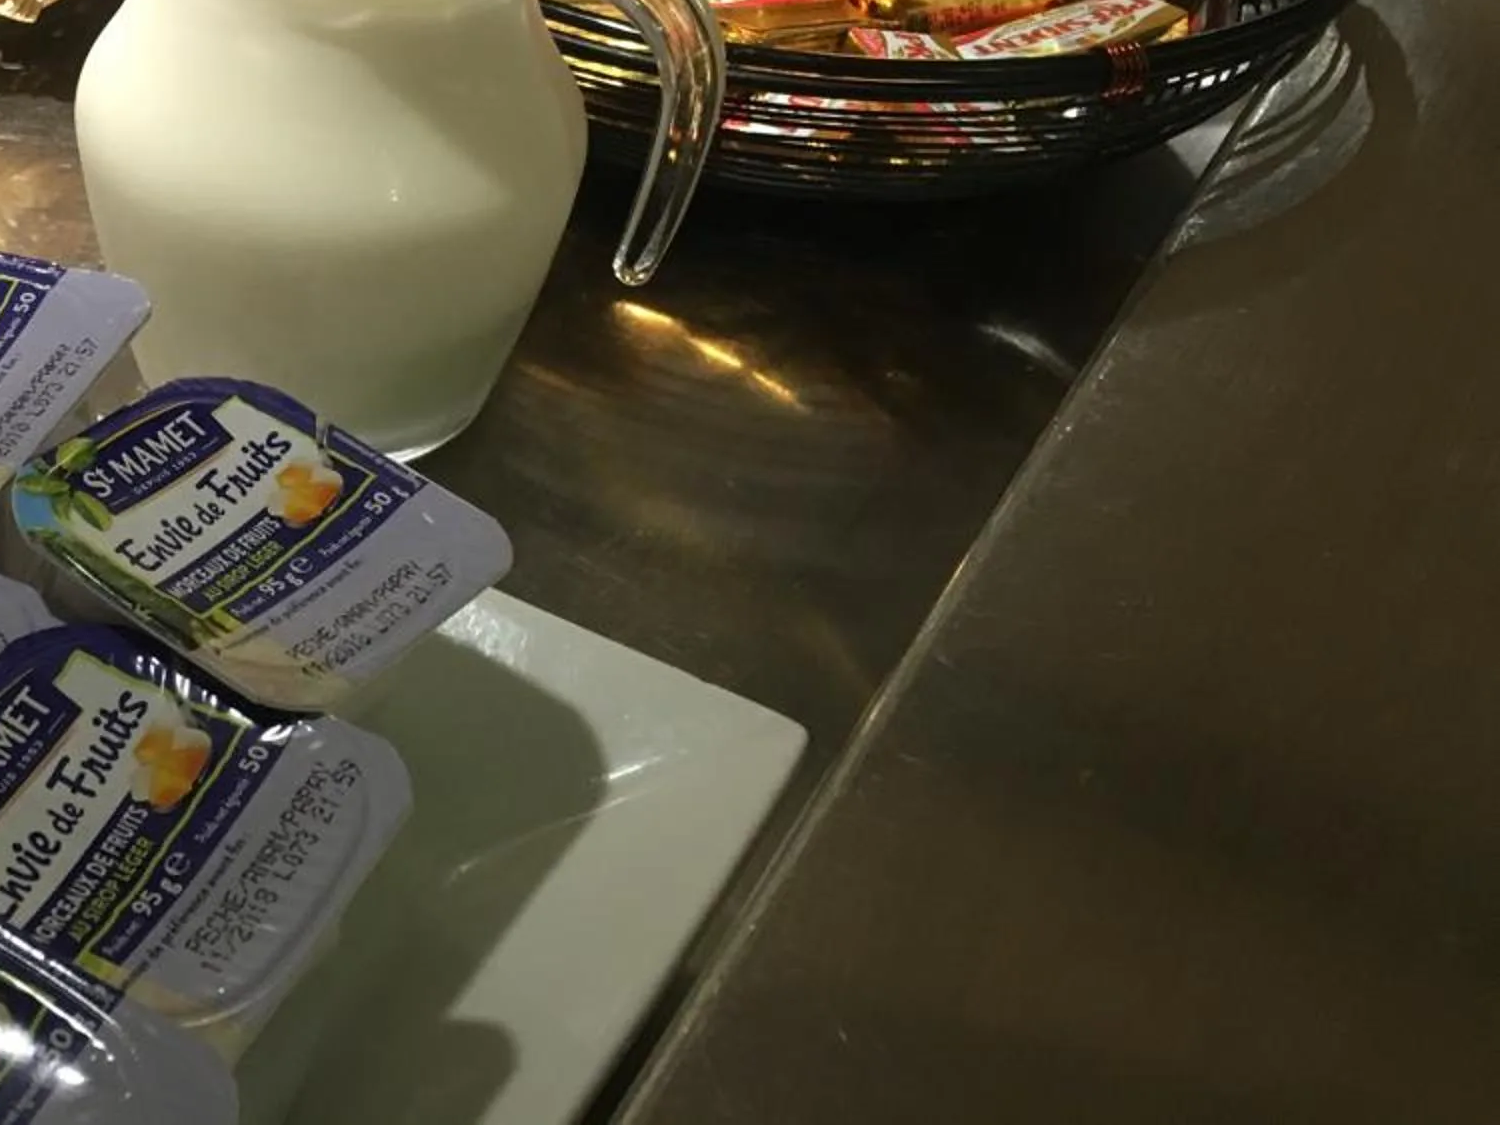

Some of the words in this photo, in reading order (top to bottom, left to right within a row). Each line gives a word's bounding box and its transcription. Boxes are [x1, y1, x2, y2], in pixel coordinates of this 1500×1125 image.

[13, 292, 41, 316] 50
[82, 467, 115, 497] St
[112, 412, 207, 481] MAMET
[197, 430, 288, 505] Fruits
[196, 500, 227, 525] de
[363, 492, 396, 518] 50
[116, 516, 202, 571] Envie
[164, 553, 230, 599] MORCEAUX
[222, 541, 247, 561] DE
[237, 514, 282, 550] FRUITS
[255, 574, 286, 600] 95
[48, 690, 145, 802] Fruits
[236, 740, 271, 776] 50
[49, 800, 85, 835] de
[87, 851, 114, 877] DE
[101, 804, 150, 858] FRUITS
[128, 885, 164, 921] 95
